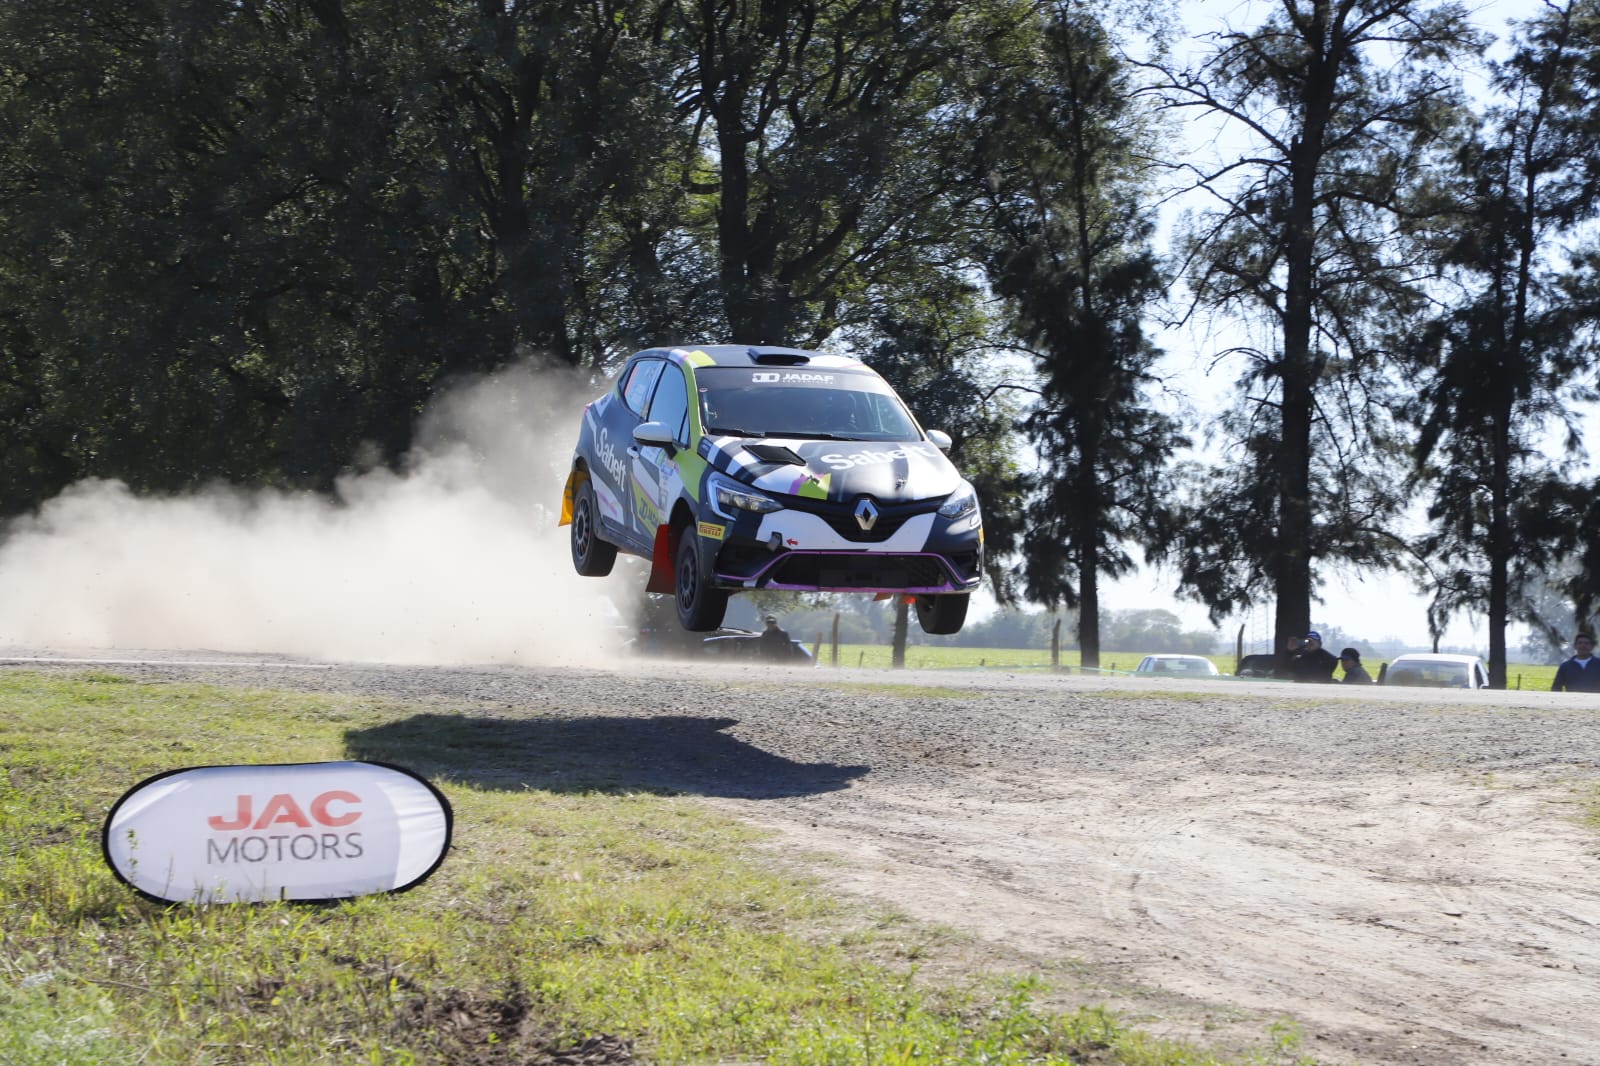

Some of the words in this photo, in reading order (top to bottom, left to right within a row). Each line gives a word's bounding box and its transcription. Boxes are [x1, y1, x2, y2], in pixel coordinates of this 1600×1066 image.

[596, 427, 626, 492] Sabelt
[820, 445, 937, 470] Sabelt
[208, 790, 362, 831] JAC
[207, 832, 363, 864] MOTORS
